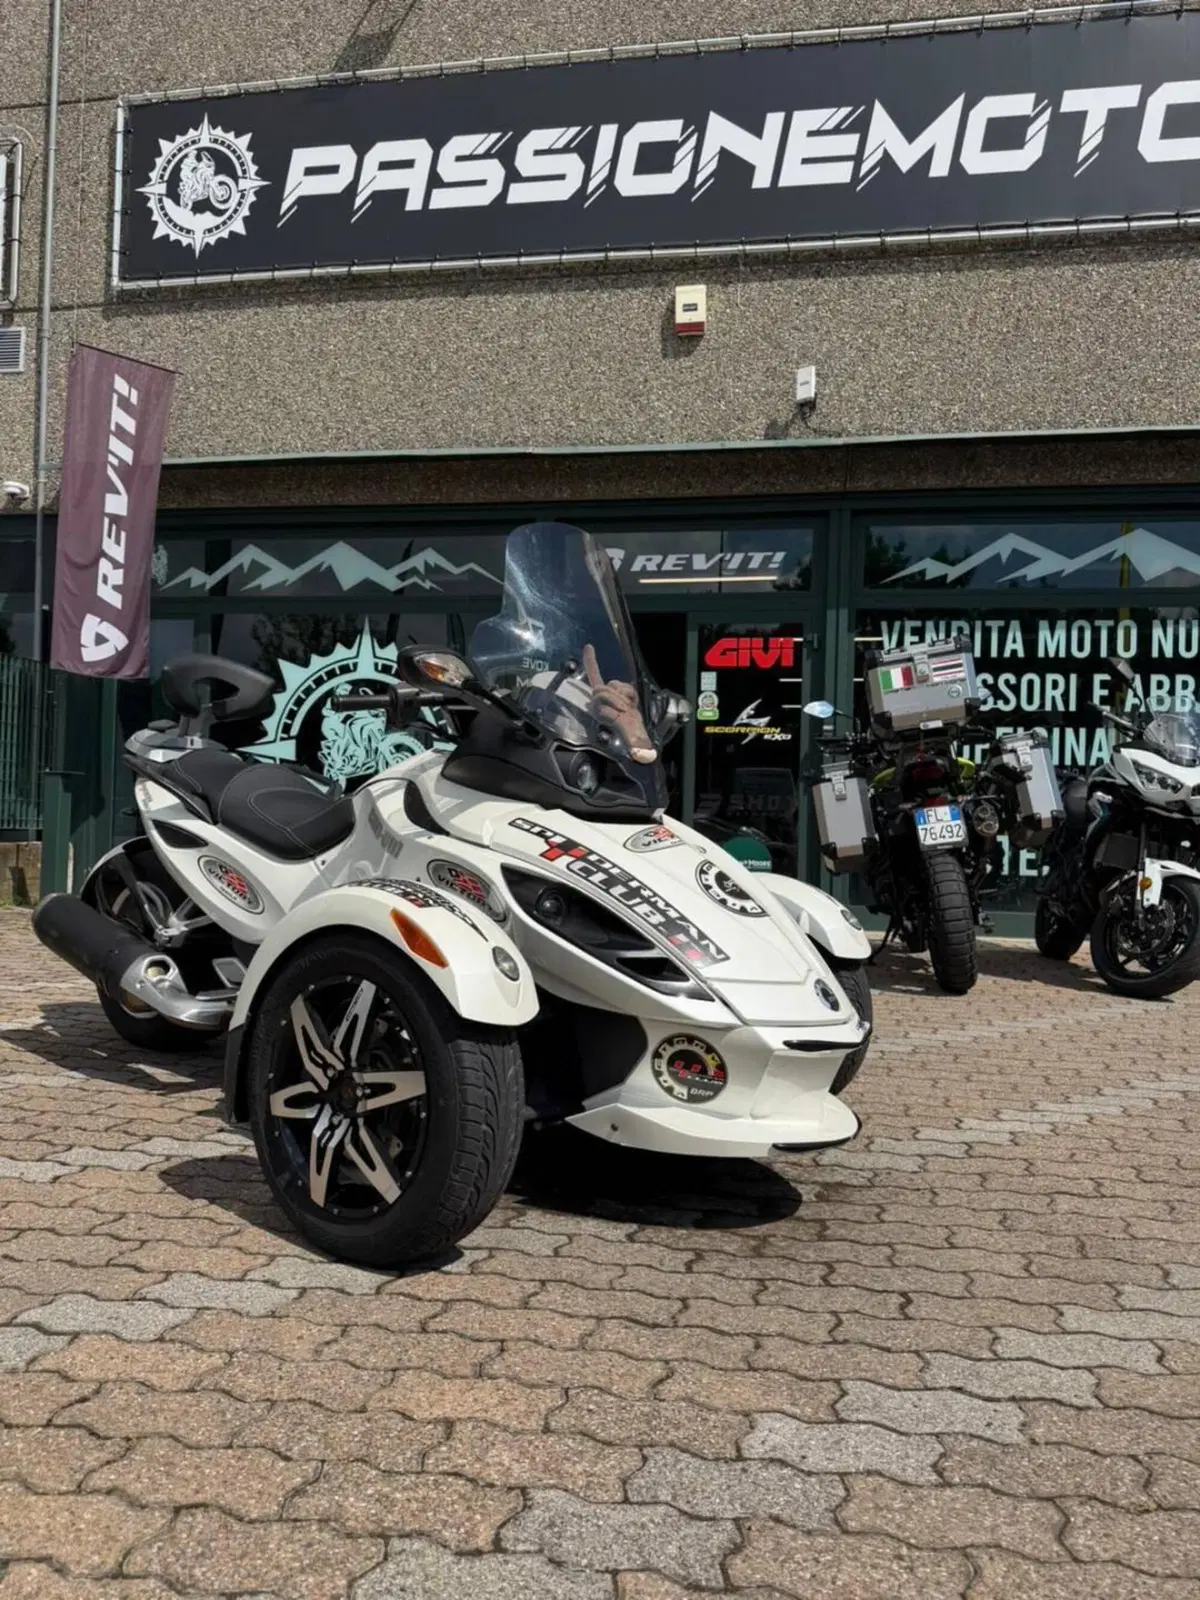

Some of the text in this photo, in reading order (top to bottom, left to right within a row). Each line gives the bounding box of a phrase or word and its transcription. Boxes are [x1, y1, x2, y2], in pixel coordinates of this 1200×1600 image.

[277, 80, 1200, 228] PASSIONEMOTO
[96, 373, 138, 610] REV'IT!
[630, 551, 787, 572] REV'IT!
[704, 637, 794, 669] GIVI
[1037, 619, 1138, 659] MOTO
[1151, 619, 1199, 659] NU
[1092, 673, 1112, 712] E
[704, 725, 781, 735] SCORPION
[926, 808, 943, 823] FL
[920, 823, 963, 842] 76492
